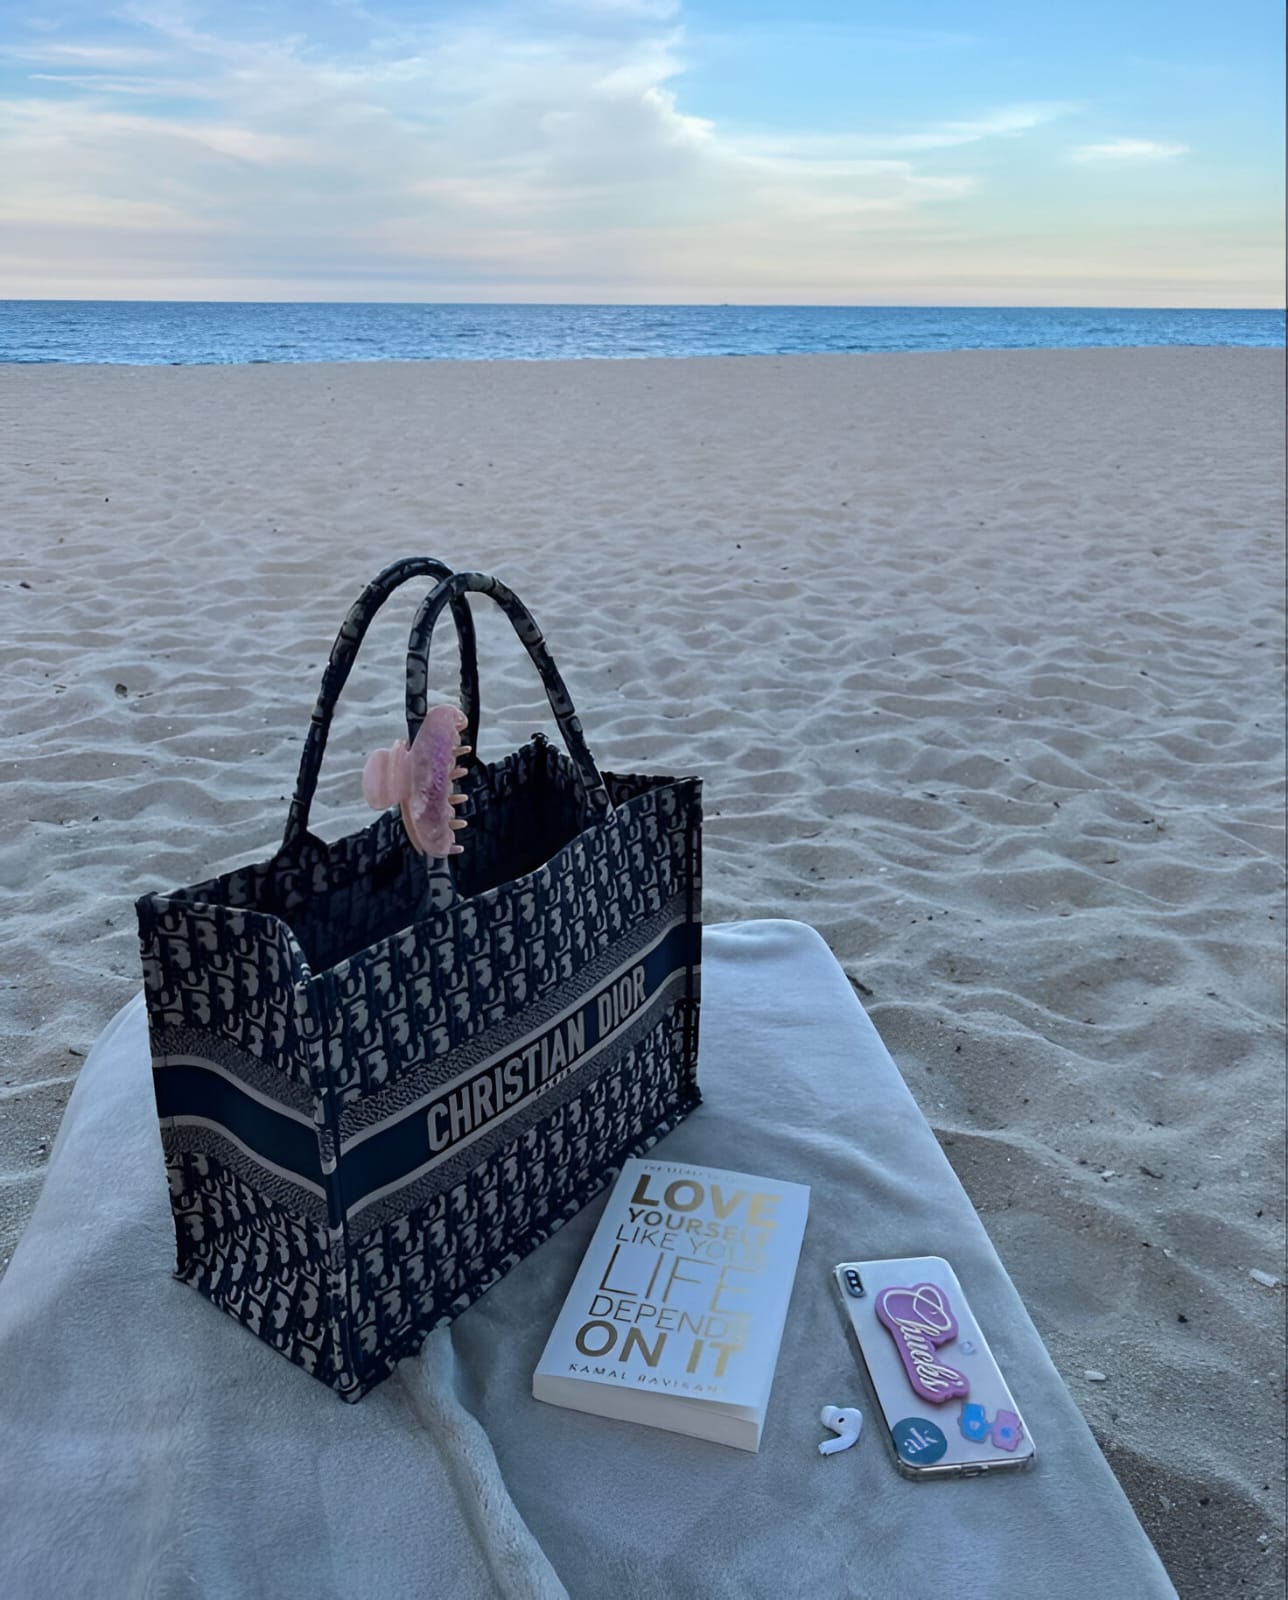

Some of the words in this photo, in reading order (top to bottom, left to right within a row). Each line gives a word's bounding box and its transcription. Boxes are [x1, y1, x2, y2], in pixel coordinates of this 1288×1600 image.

[427, 1010, 586, 1151] CHRISTIAN
[598, 964, 647, 1040] DIOR
[630, 1174, 783, 1230] LOVE
[615, 1224, 678, 1252] LIKE
[598, 1243, 762, 1318] LIFE
[588, 1294, 751, 1342] DEPEND
[575, 1319, 667, 1369] ON
[686, 1338, 745, 1377] IT
[568, 1363, 627, 1380] KAMAL
[637, 1374, 728, 1393] RAVIKAN
[903, 1427, 938, 1454] ak
